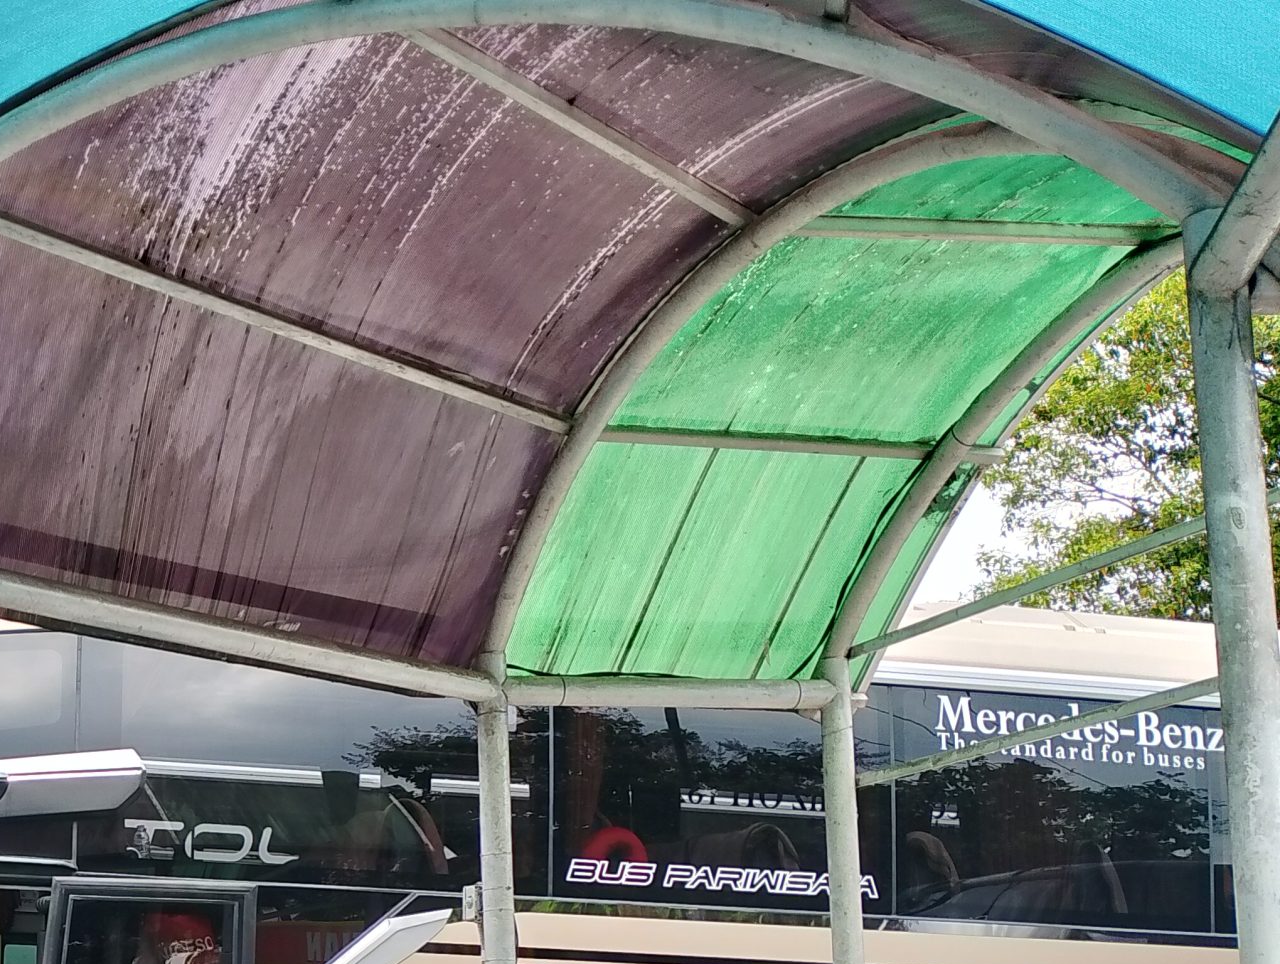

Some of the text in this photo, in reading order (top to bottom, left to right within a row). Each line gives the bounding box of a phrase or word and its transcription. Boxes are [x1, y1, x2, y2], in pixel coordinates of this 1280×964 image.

[937, 732, 1206, 770] Th tandard for buses
[566, 858, 879, 899] BUS PARIWISAA
